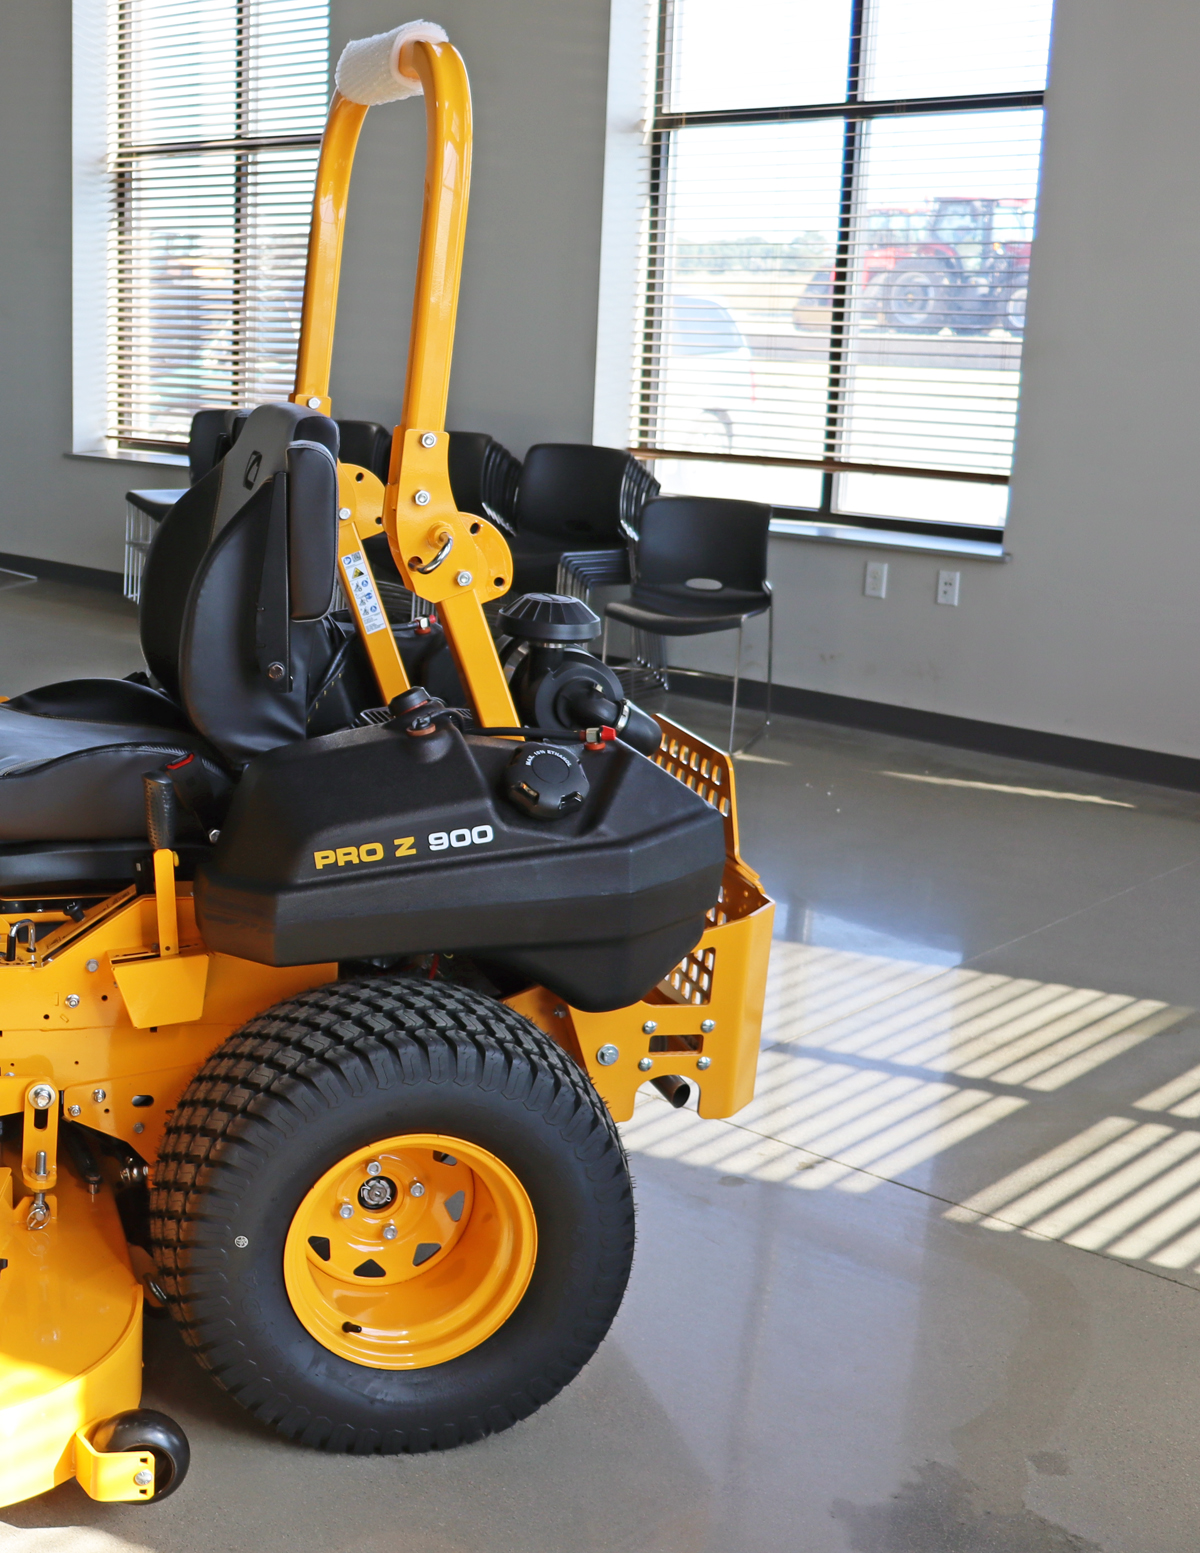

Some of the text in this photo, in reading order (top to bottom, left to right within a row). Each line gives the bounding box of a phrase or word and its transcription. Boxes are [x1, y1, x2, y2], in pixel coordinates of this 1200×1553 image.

[313, 824, 494, 870] PRO Z 900
